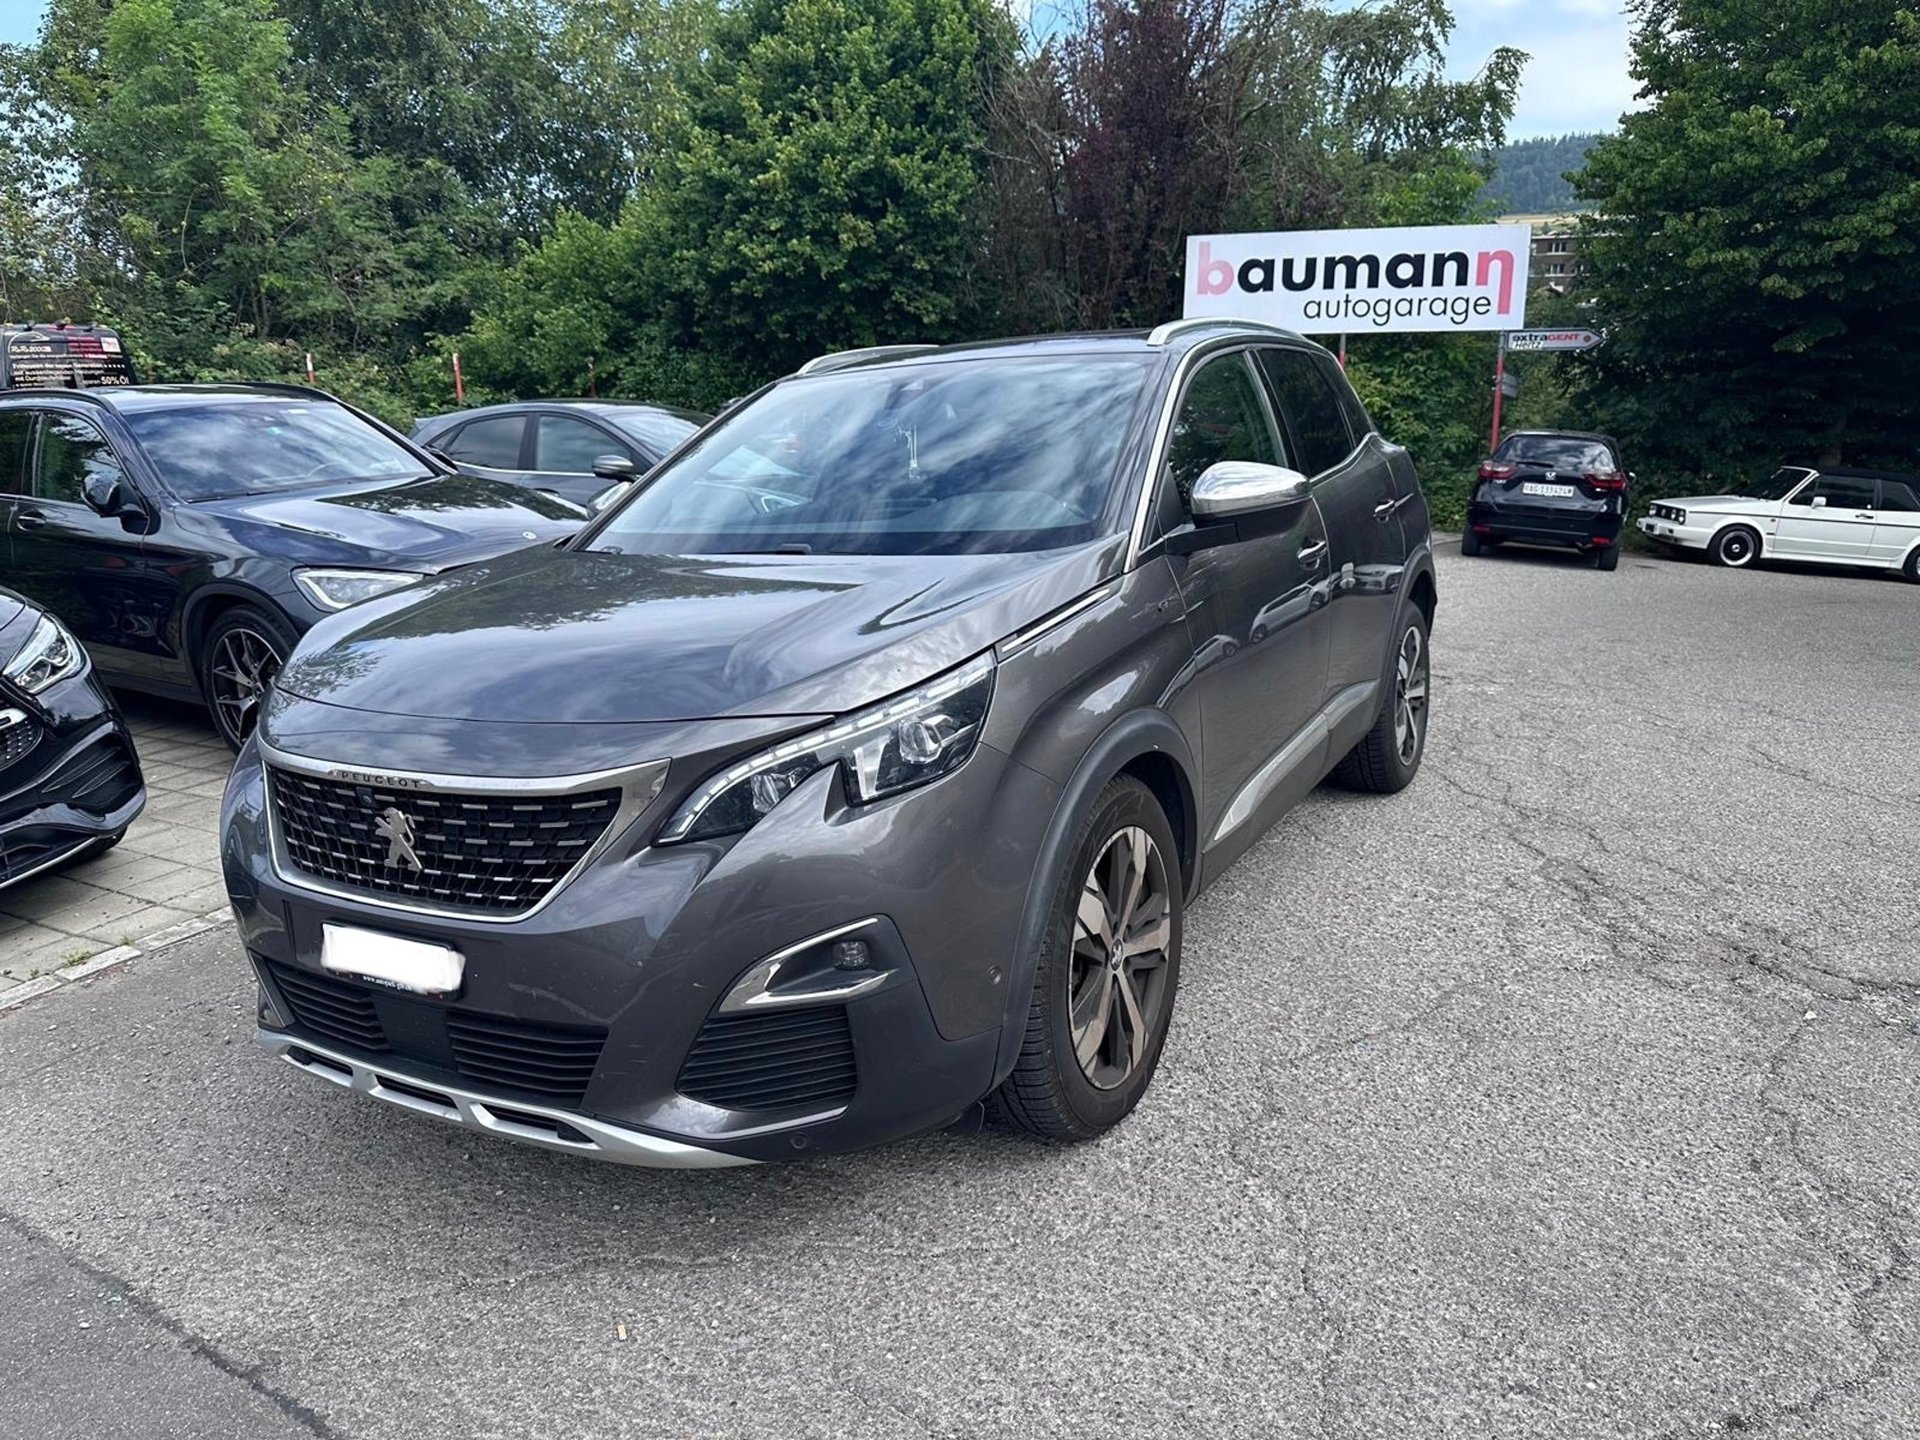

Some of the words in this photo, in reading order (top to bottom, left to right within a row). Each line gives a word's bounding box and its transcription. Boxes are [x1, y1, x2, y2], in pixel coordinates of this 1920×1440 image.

[1196, 241, 1515, 315] baumann
[1303, 294, 1491, 325] autogarage
[101, 376, 120, 385] 50%
[341, 773, 420, 788] PEUGEOT
